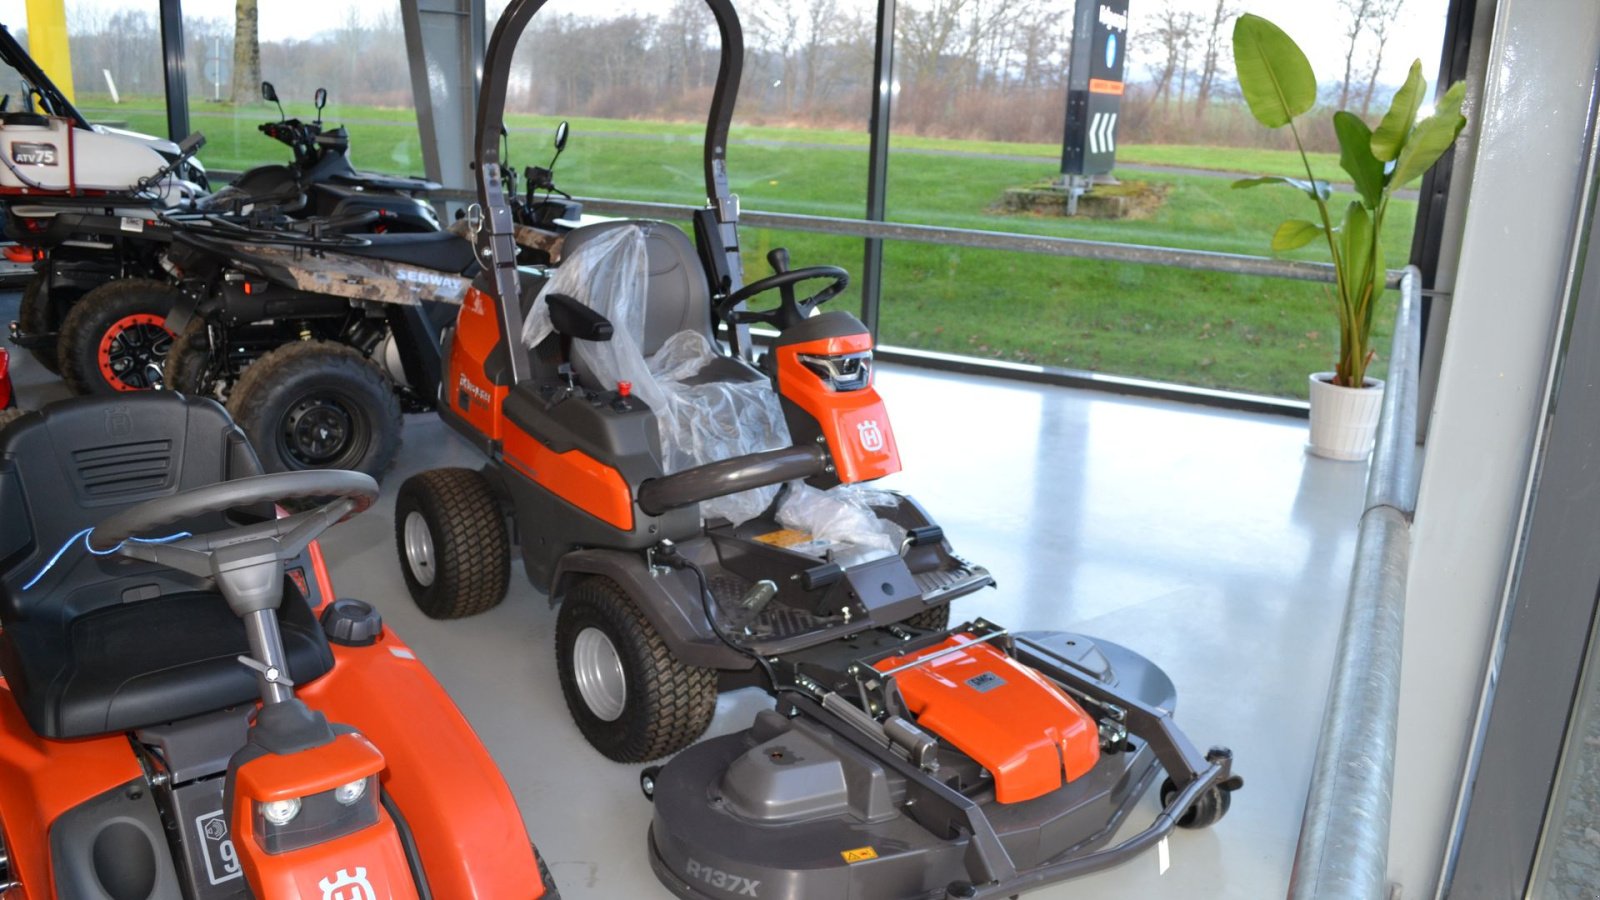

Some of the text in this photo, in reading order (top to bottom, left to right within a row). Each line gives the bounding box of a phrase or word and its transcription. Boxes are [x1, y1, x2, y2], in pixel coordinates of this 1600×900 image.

[396, 269, 462, 289] SEGWAY
[220, 840, 242, 873] 9
[686, 857, 760, 897] R137X
